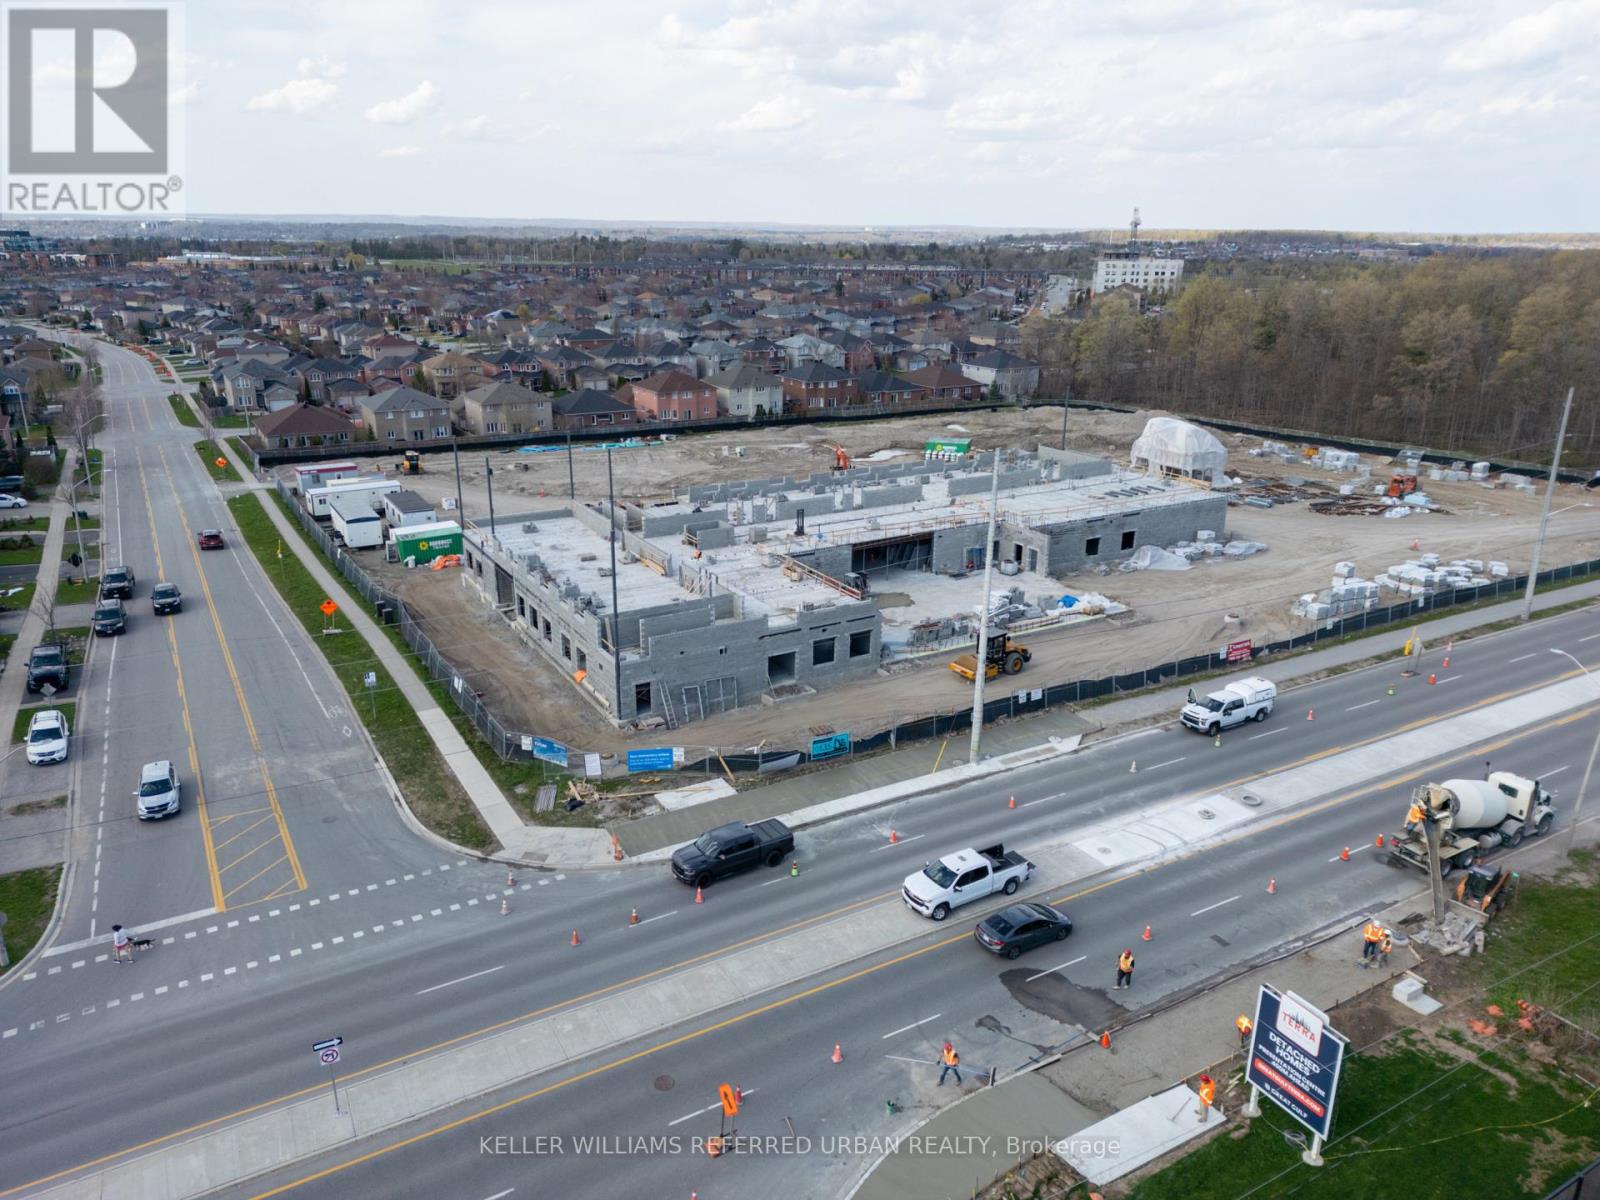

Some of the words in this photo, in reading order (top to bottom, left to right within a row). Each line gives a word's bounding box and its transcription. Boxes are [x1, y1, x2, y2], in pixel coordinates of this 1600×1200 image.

[1282, 1010, 1316, 1043] TERRA
[1268, 1031, 1320, 1074] DETACHED
[1275, 1044, 1310, 1076] HOMES
[1258, 1043, 1302, 1080] PRESENTATION
[1302, 1076, 1325, 1097] CENTRE
[1271, 1087, 1291, 1106] GREAT
[1290, 1103, 1308, 1119] GULF
